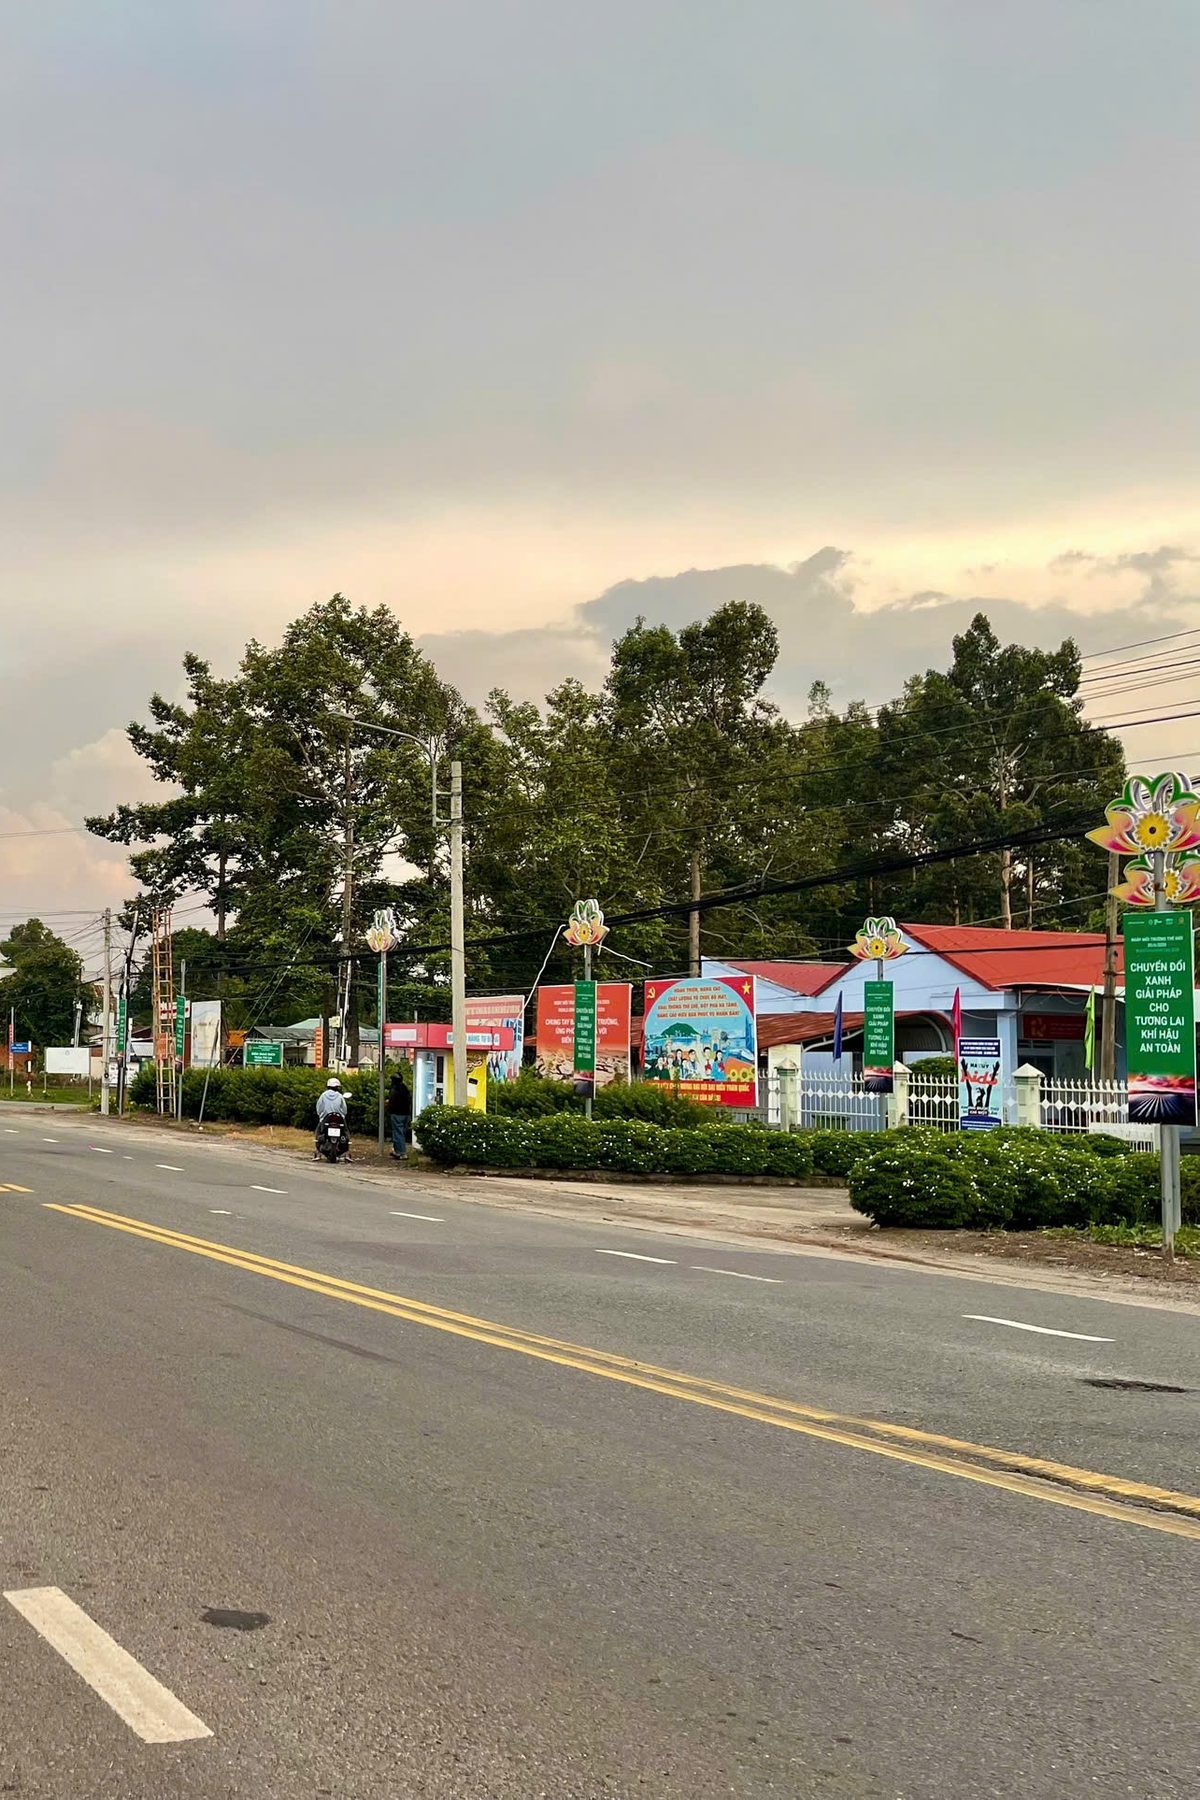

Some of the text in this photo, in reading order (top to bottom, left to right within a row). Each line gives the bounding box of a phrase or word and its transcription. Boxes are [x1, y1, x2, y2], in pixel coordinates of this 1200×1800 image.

[1130, 959, 1186, 972] CHUYỂN ĐỔI
[1145, 975, 1171, 985] XANH
[1135, 987, 1182, 999] GIẢI PHÁP
[1149, 1003, 1169, 1012] CHO
[1135, 1016, 1185, 1026] TƯƠNG LAI
[1141, 1028, 1179, 1041] KHÍ HẬU
[1140, 1042, 1181, 1053] AN TOÀN
